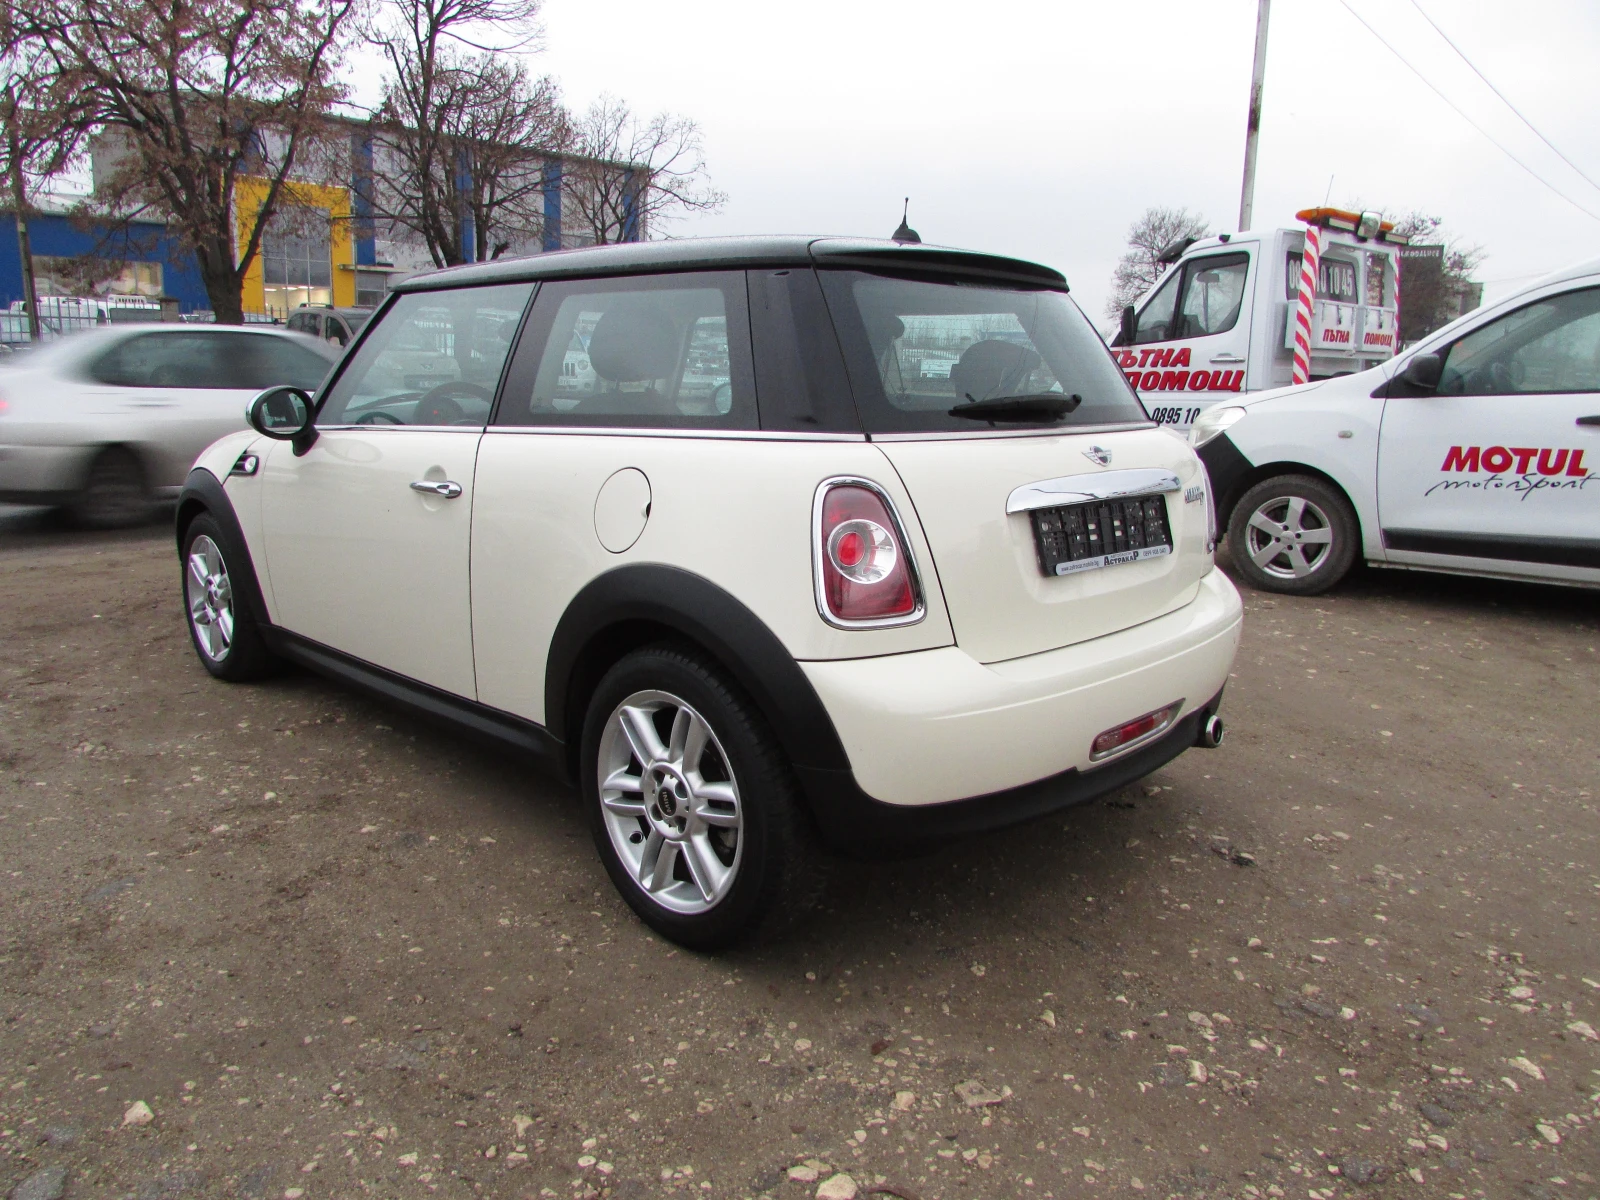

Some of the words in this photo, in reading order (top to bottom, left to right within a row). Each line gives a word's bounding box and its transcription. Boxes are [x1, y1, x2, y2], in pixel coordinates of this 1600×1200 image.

[1329, 266, 1340, 294] 10
[1342, 268, 1353, 296] 45
[1323, 329, 1350, 343] ПЪТНА
[1364, 332, 1393, 347] ПОМОЩ
[1151, 408, 1182, 424] 0895
[1441, 446, 1588, 476] MOTUL
